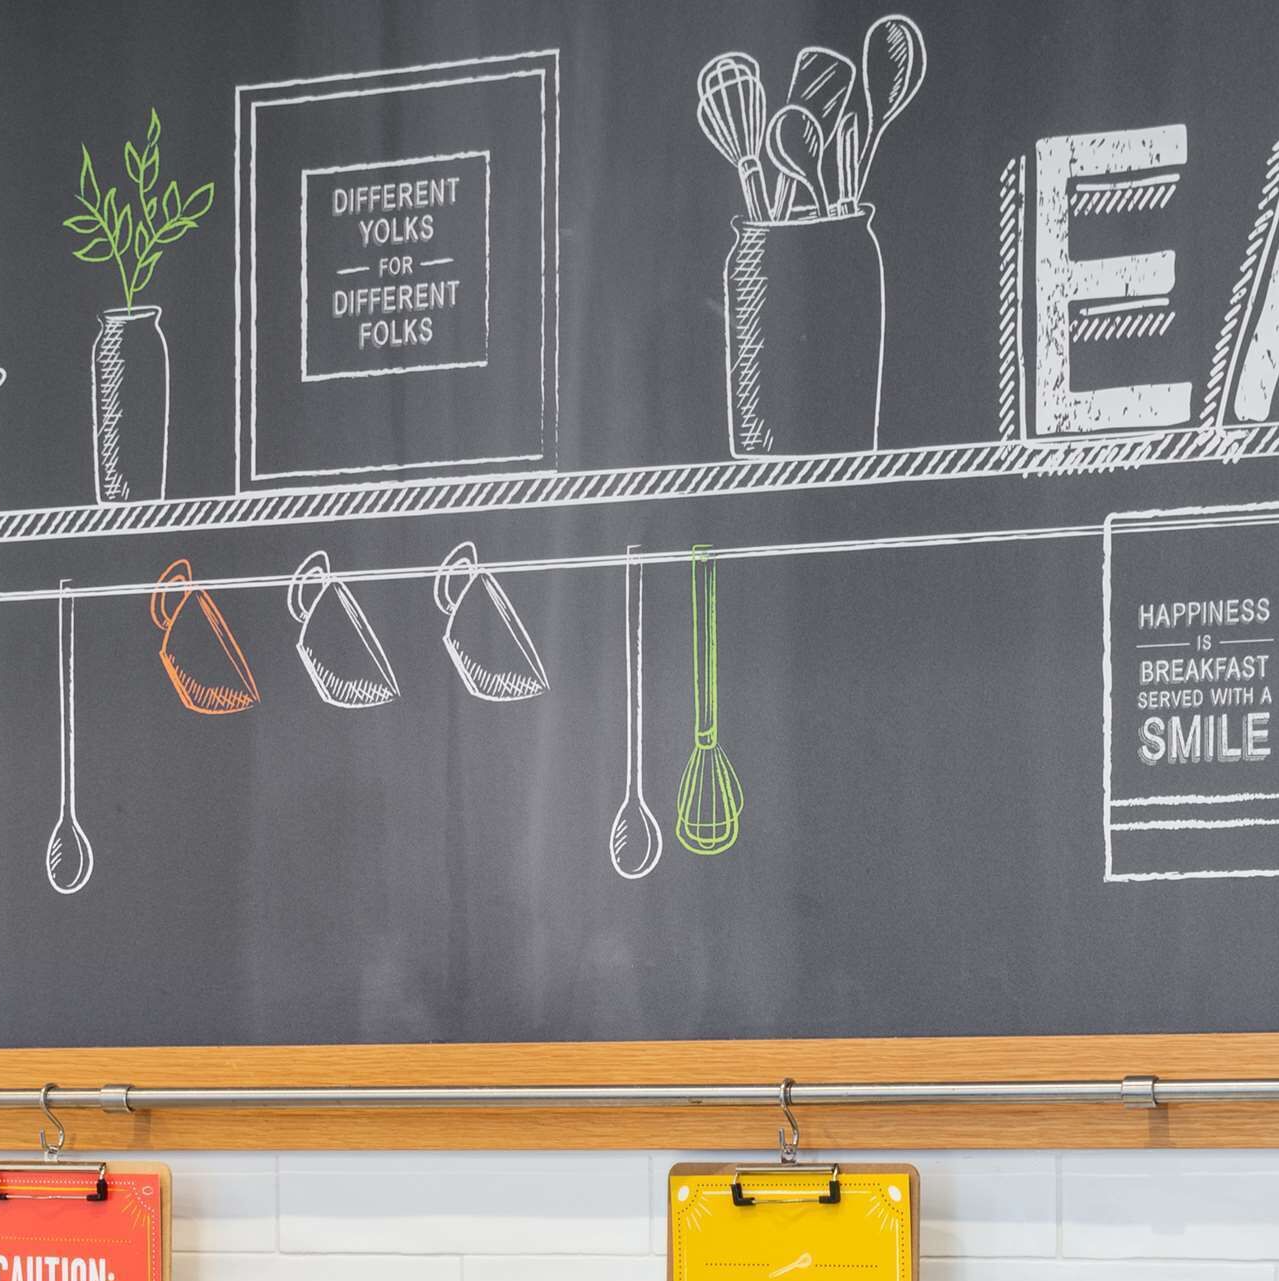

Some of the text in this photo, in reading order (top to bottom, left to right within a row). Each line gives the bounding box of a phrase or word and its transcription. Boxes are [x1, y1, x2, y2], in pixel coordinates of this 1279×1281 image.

[332, 177, 460, 216] DIFFERENT
[359, 214, 435, 248] YOLKS
[378, 256, 413, 277] FOR
[332, 280, 460, 319] DIFFERENT
[358, 317, 433, 350] FOLKS
[1138, 598, 1271, 630] HAPPINESS
[1196, 634, 1212, 651] IS
[1140, 655, 1270, 685] BREAKFAST
[1137, 686, 1272, 709] SERVED WITH A
[1138, 711, 1271, 766] SMILE
